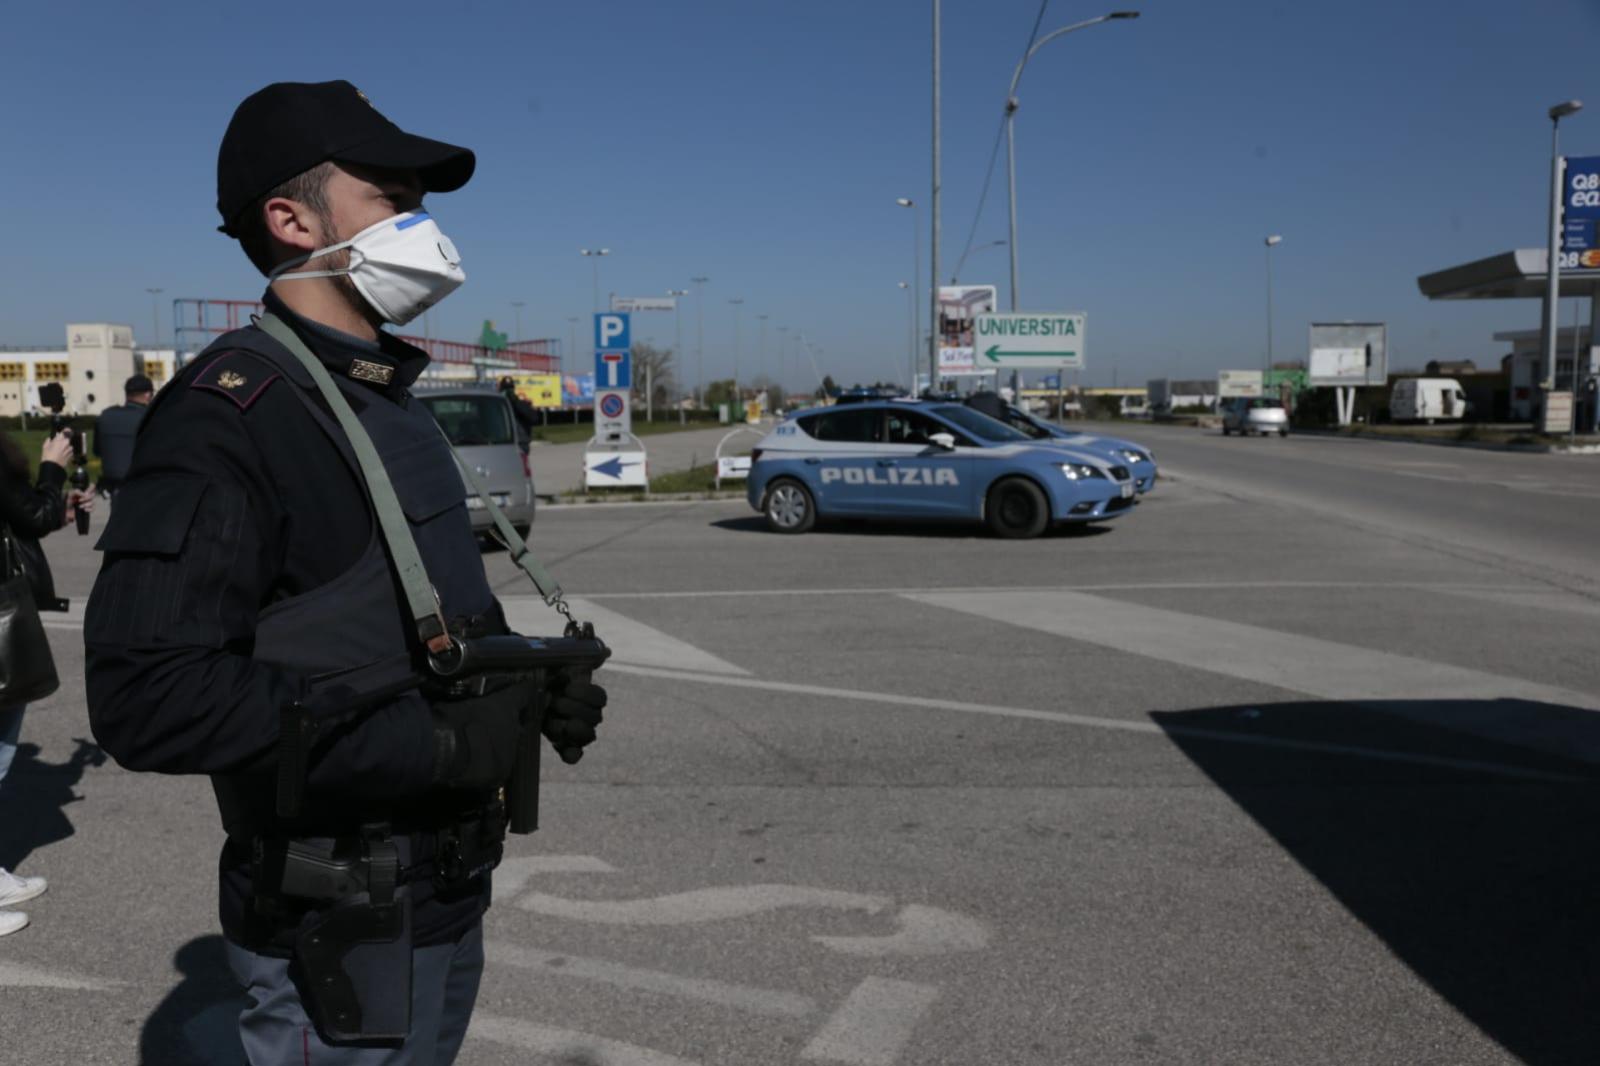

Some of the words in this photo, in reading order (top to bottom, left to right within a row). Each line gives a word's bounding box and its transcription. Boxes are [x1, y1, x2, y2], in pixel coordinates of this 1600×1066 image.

[1571, 173, 1599, 191] Q8
[600, 315, 624, 347] P
[819, 466, 960, 486] POLIZIA
